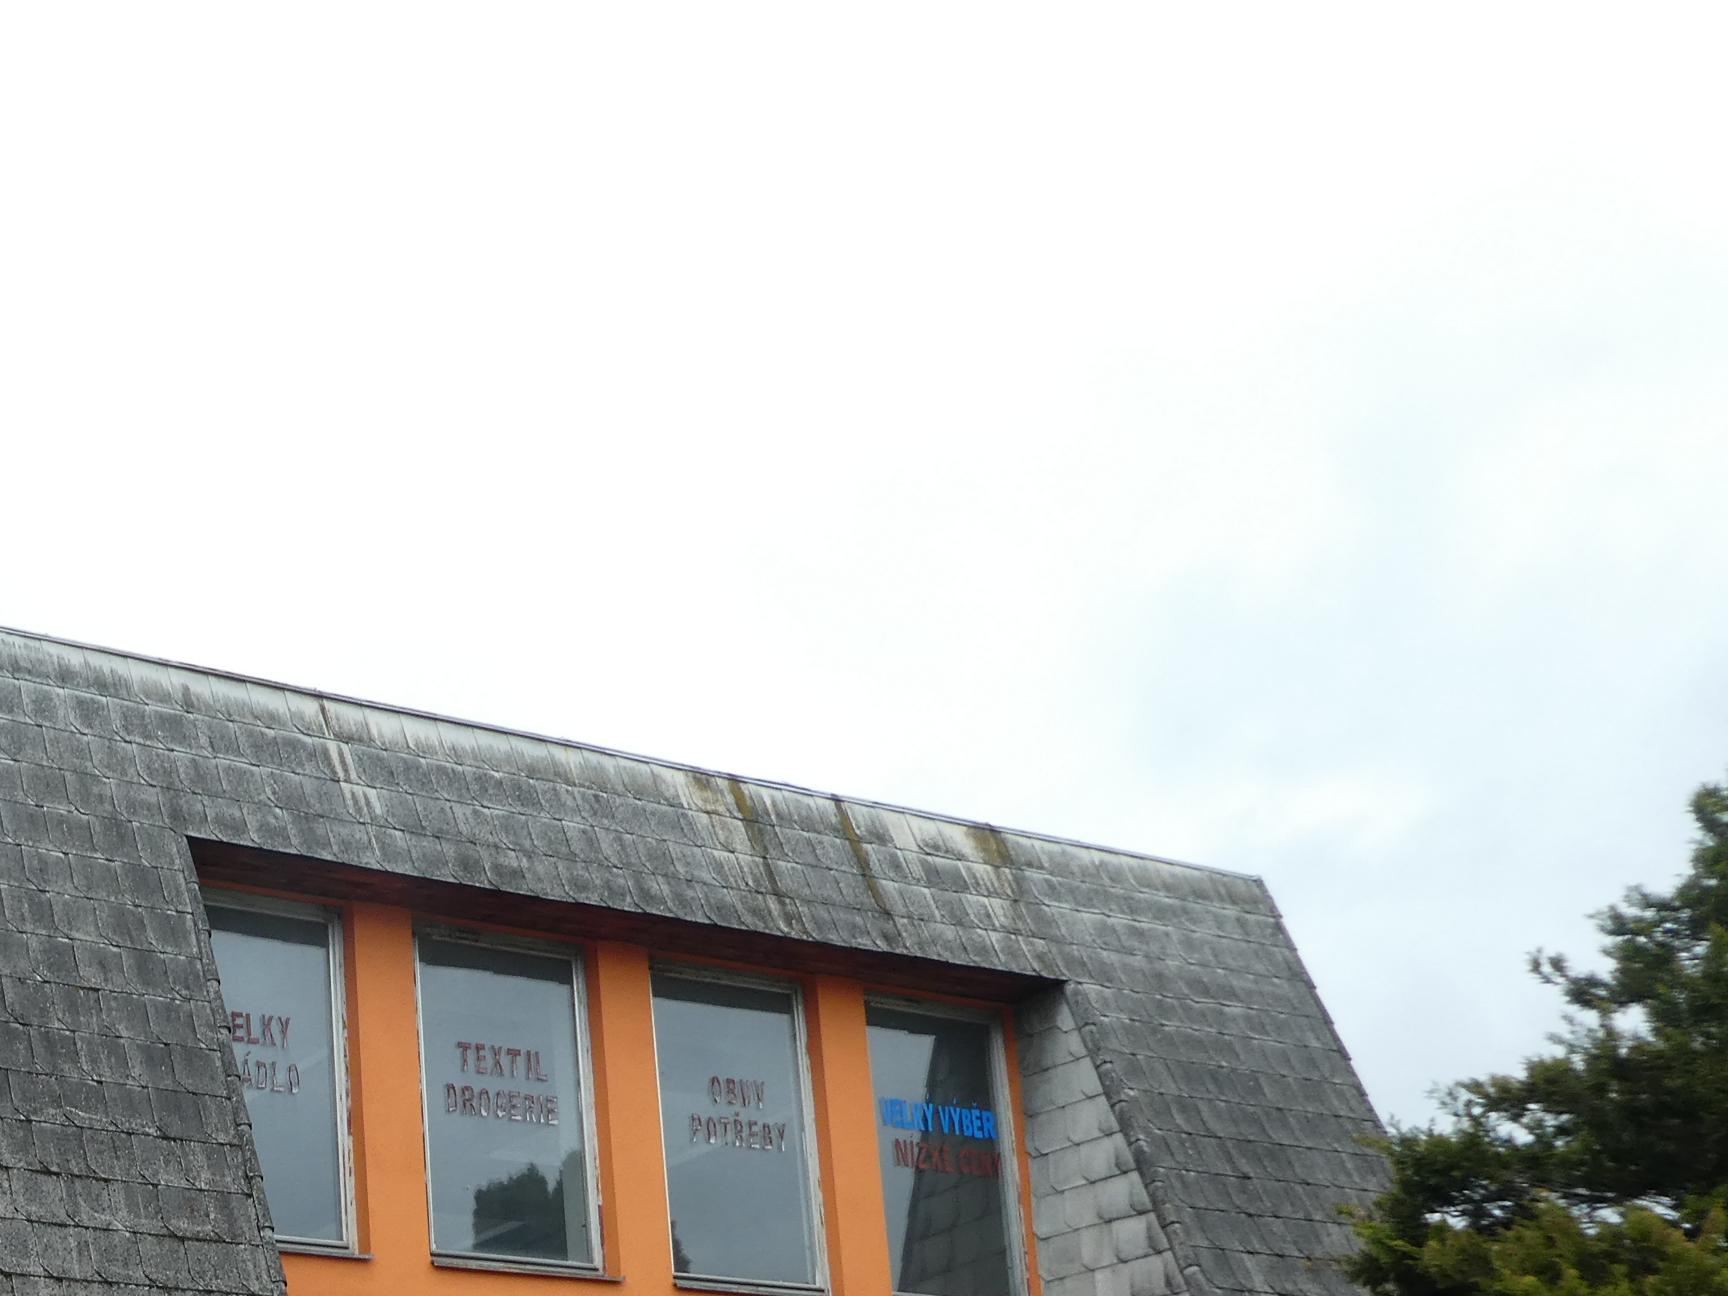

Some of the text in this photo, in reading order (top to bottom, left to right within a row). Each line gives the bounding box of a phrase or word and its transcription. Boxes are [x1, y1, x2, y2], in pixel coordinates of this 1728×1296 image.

[231, 1011, 291, 1049] ELKY
[241, 1050, 300, 1095] ÁDLO
[457, 1041, 548, 1082] TEXTIL
[937, 1097, 998, 1139] VÝBĚR
